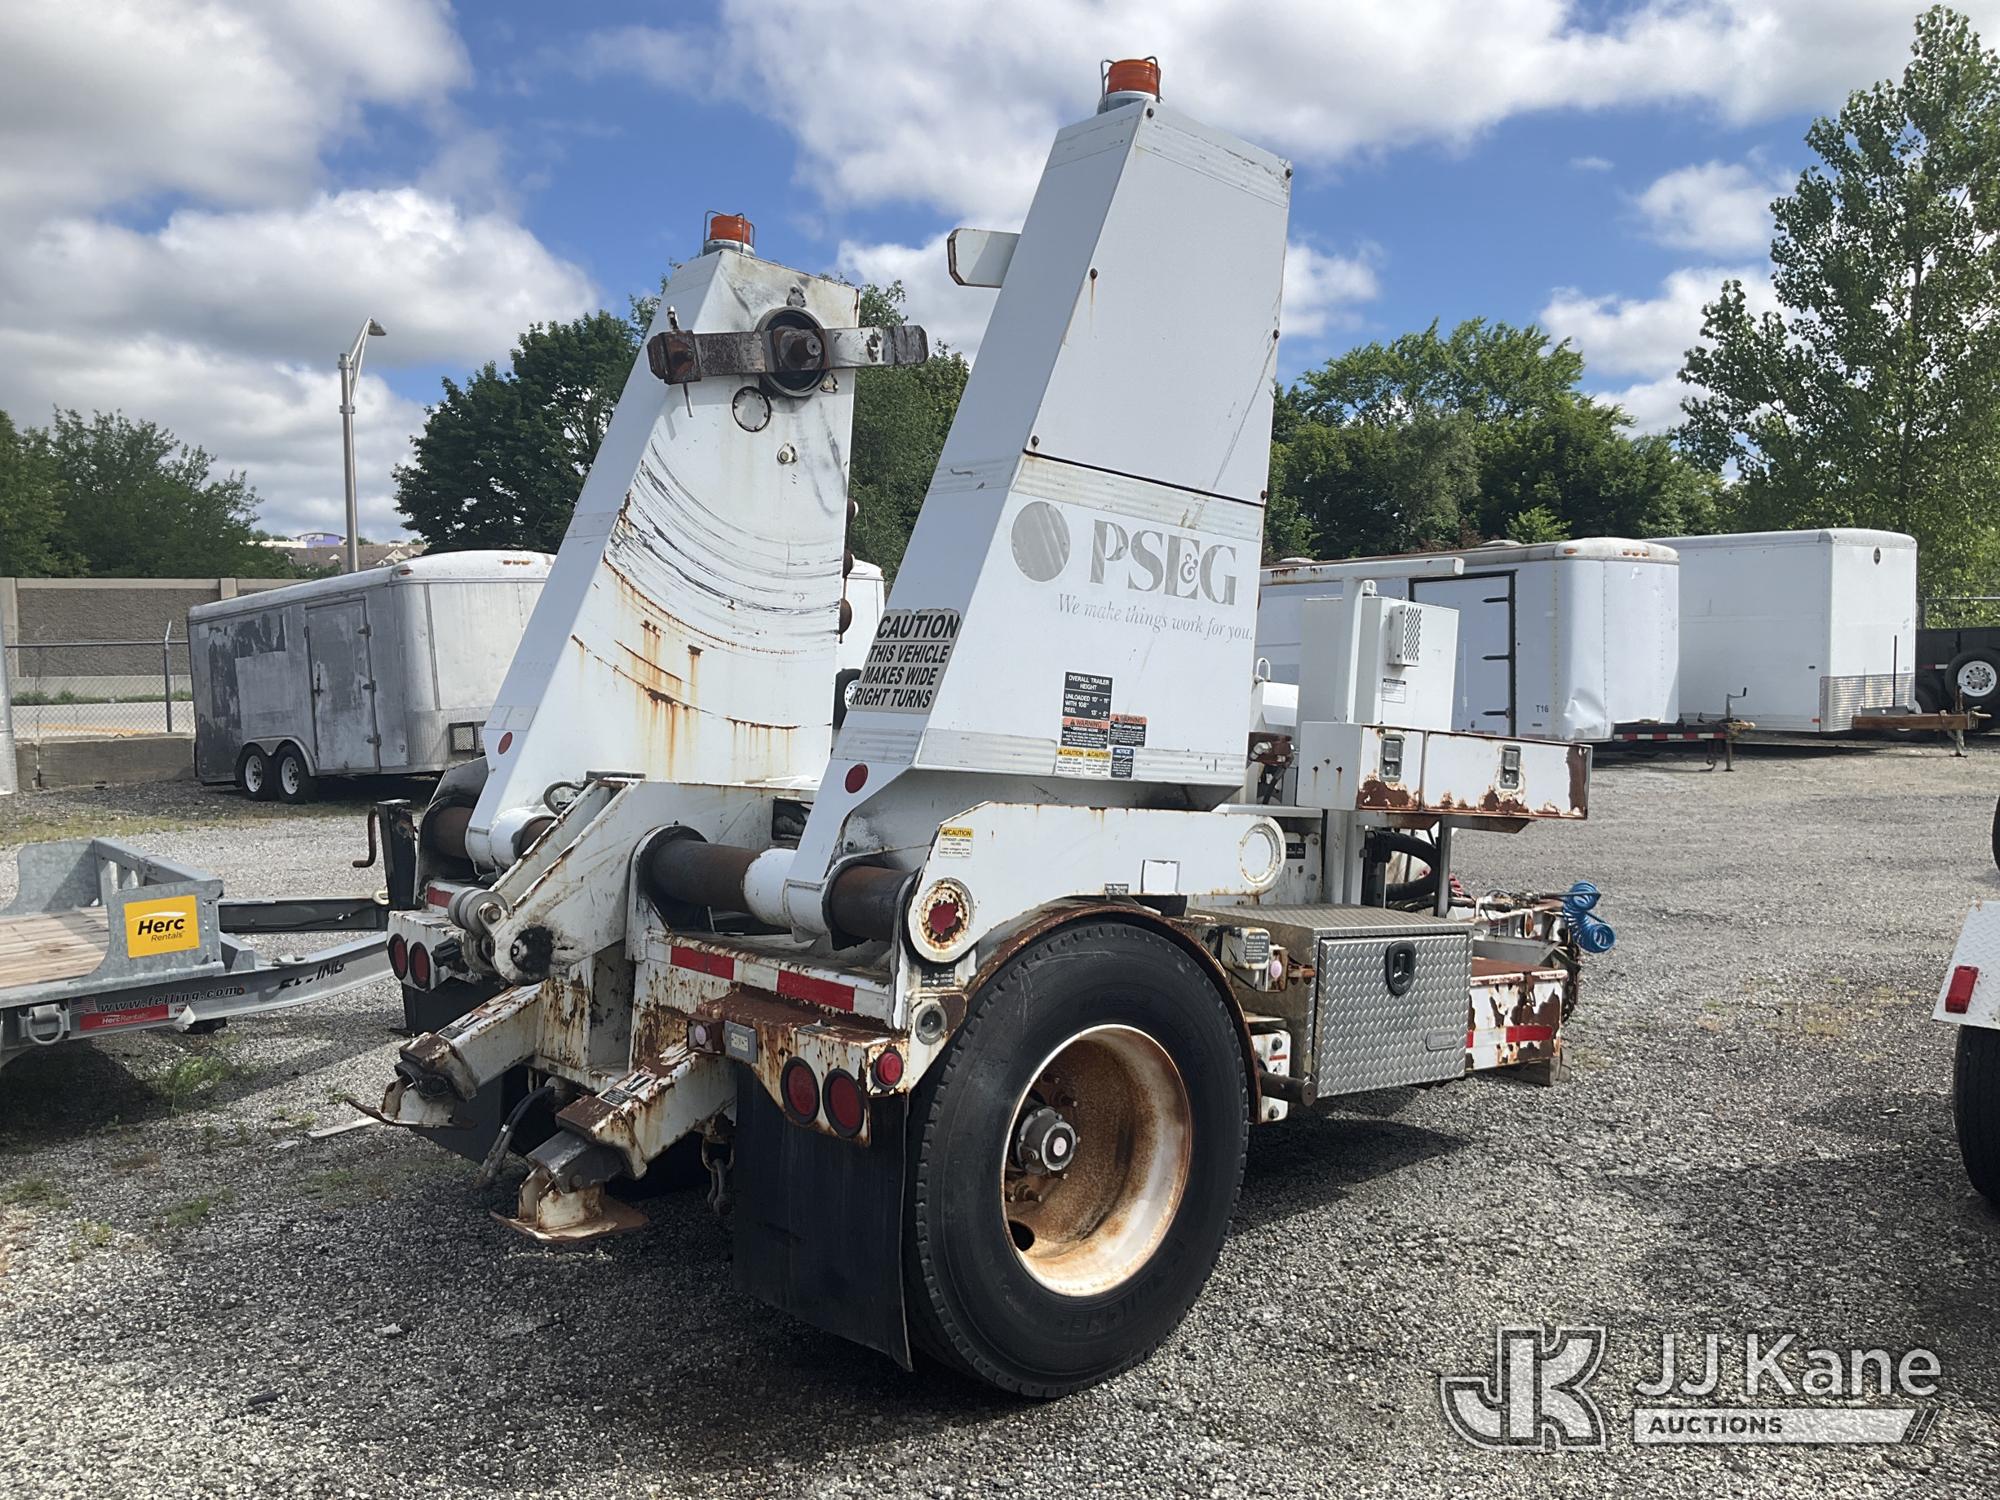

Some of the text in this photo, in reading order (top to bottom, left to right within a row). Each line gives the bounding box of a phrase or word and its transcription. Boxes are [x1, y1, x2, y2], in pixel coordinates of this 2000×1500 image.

[1090, 519, 1237, 606] PSE&G
[877, 615, 960, 639] CAUTION
[1058, 593, 1253, 643] We make things work for you.
[868, 645, 950, 663] THIS VEHICLE
[862, 666, 939, 685] MAKES WIDE
[1069, 675, 1090, 683] OVERALL
[852, 688, 933, 708] RIGHT TURNS
[1065, 693, 1090, 701] UNLOADED
[1064, 706, 1076, 714] REEL
[138, 919, 185, 935] Herc
[151, 931, 183, 942] Rentals
[101, 986, 238, 1013] www.felling.com
